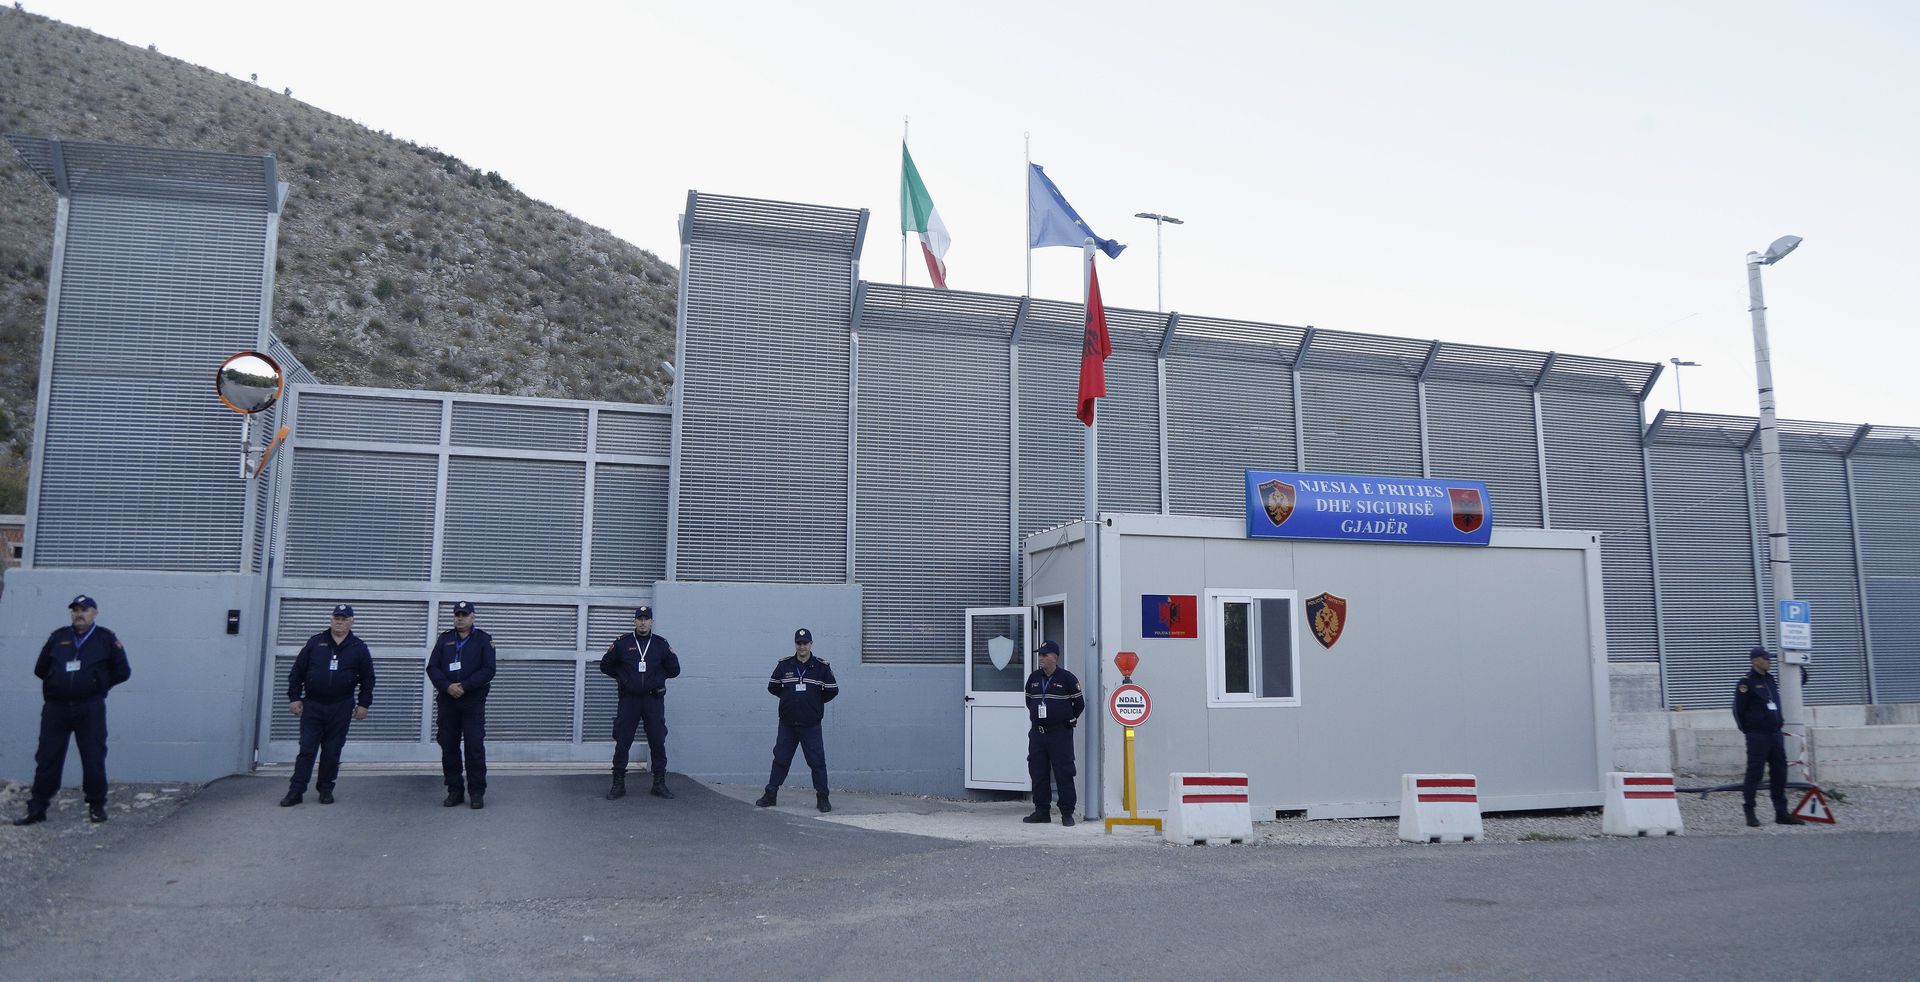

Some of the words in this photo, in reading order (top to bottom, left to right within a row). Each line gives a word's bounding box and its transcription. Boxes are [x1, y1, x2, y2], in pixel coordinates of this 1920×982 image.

[1299, 479, 1359, 494] NJESIA
[1363, 483, 1374, 495] E
[1376, 483, 1444, 498] PRITJES
[1317, 498, 1352, 512] DHE
[1357, 500, 1434, 516] SIGURISË
[1341, 518, 1408, 535] GJADËR
[1790, 605, 1800, 619] P
[1119, 696, 1143, 704] NDAL!
